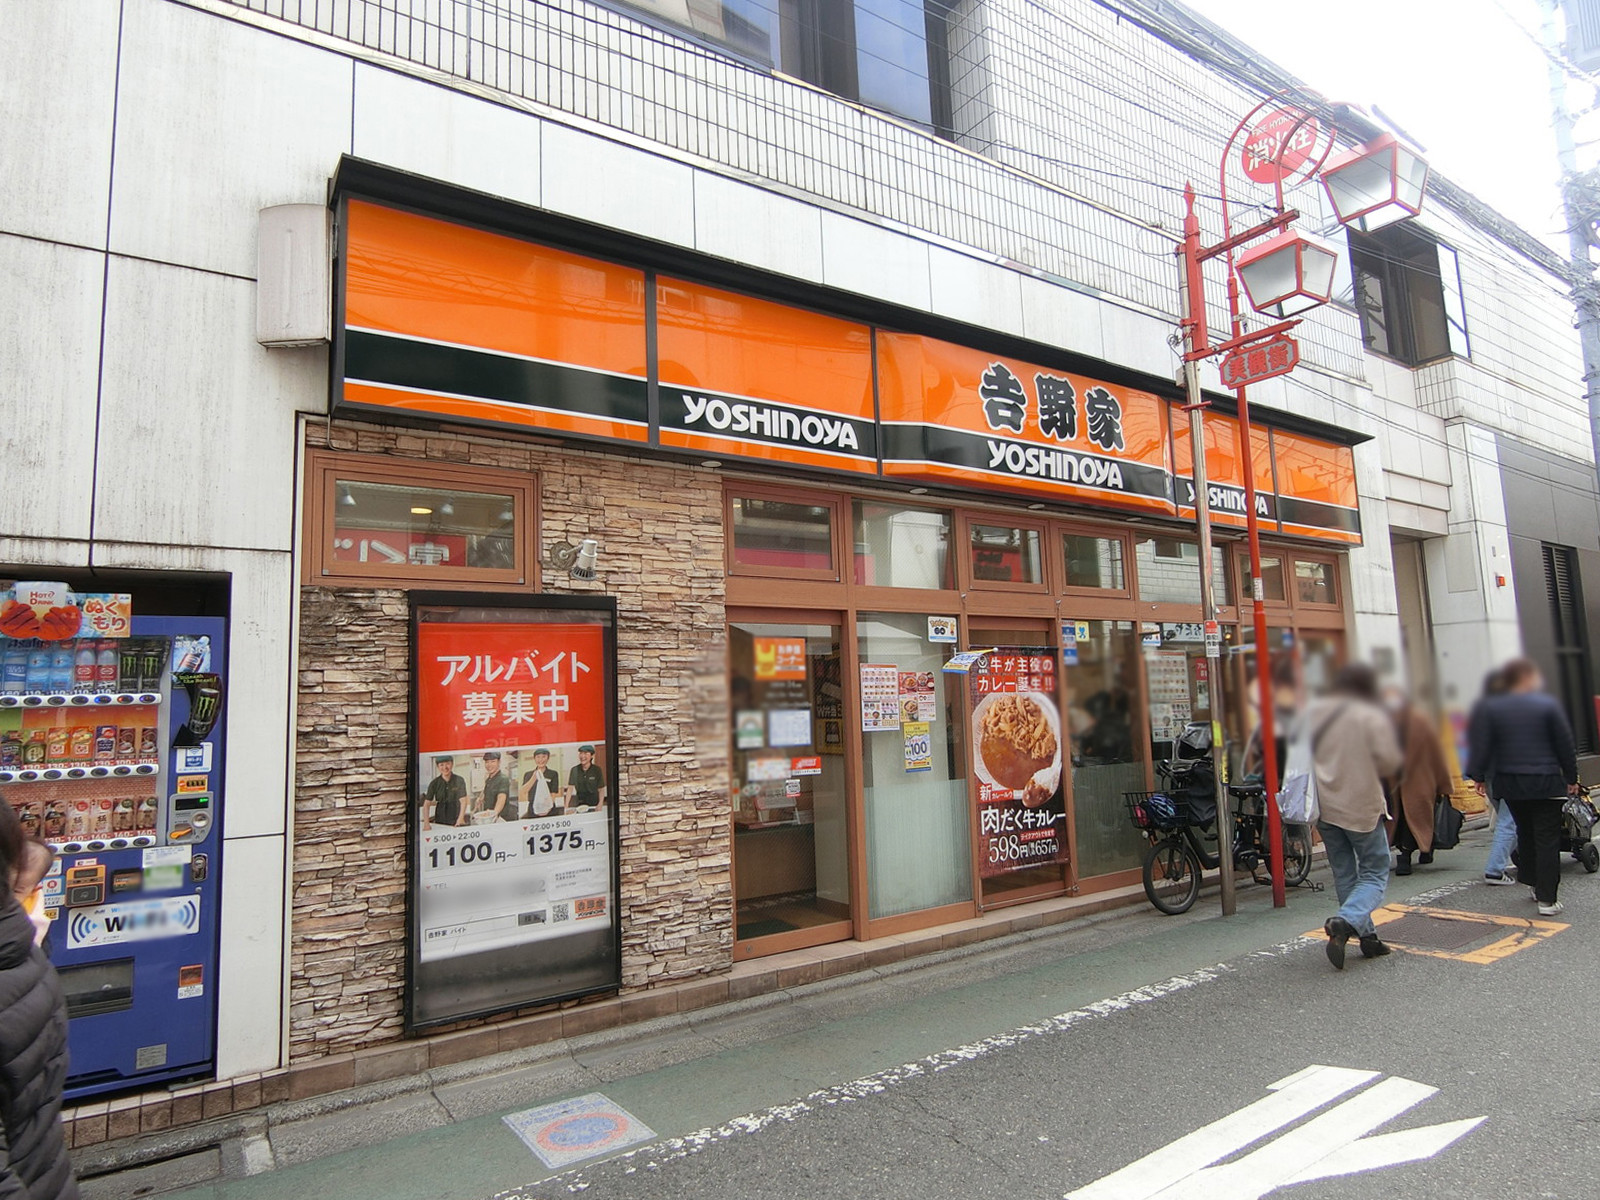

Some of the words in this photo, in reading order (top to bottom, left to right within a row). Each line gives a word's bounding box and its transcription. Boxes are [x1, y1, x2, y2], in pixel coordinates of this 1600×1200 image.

[978, 361, 1125, 452] 吉野家
[682, 394, 859, 450] YOSHINOYA
[987, 439, 1124, 489] YOSHINOYA
[86, 599, 118, 616] ぬく
[92, 616, 126, 631] もり
[436, 649, 591, 686] アルバイト
[990, 656, 1053, 673] 牛が主役の
[461, 689, 569, 727] 募集中
[529, 822, 550, 832] 22:00
[556, 820, 571, 828] 5:00
[980, 805, 1067, 835] 肉だく牛カレー
[433, 834, 452, 843] 5:00
[457, 831, 481, 841] 22:00
[427, 929, 448, 939] 吉野家
